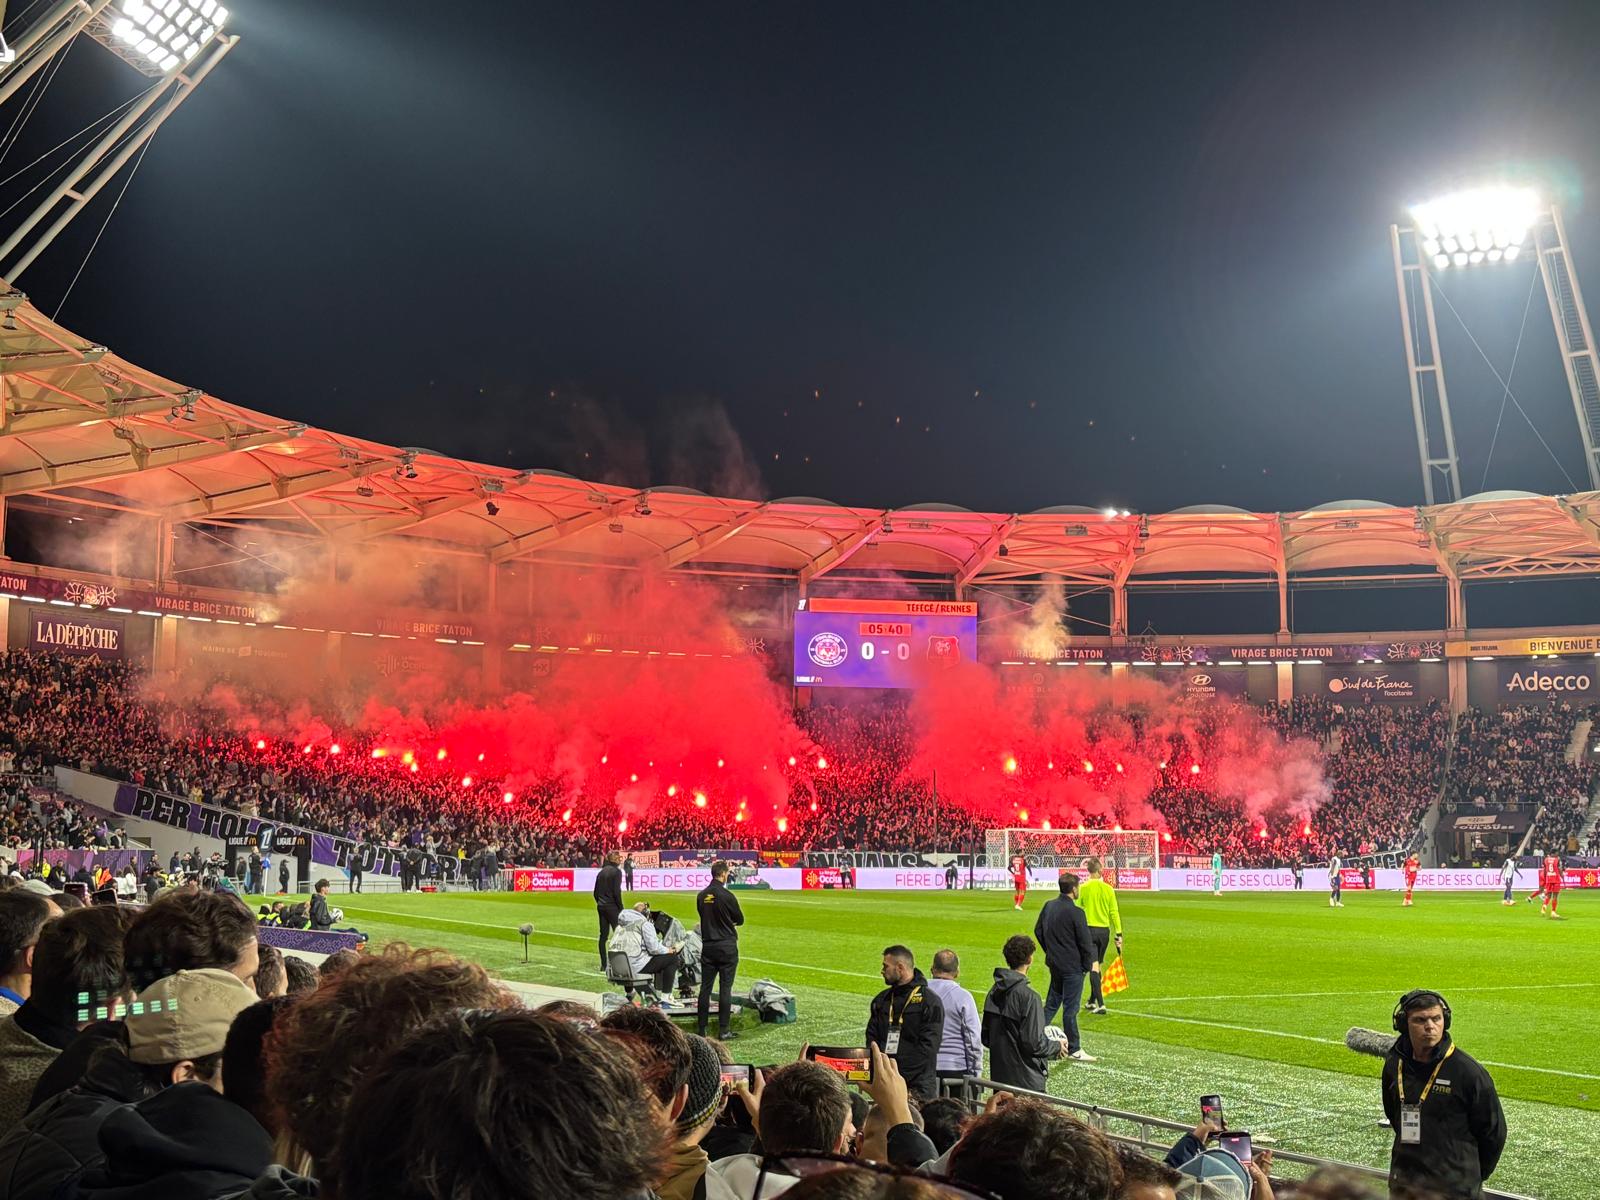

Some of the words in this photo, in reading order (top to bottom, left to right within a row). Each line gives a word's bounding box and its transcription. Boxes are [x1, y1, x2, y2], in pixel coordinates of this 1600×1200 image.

[155, 596, 190, 611] VIRAGE
[193, 601, 221, 614] BRICE
[224, 605, 255, 618] TATON
[940, 605, 972, 613] RENNES
[36, 621, 54, 643] LA
[55, 622, 118, 650] DÉPÊCHE
[413, 622, 441, 634] BRICE
[443, 624, 473, 637] TATON
[861, 642, 875, 660] 0
[897, 643, 910, 660] 0
[1530, 639, 1593, 651] BIENVENUE
[1073, 649, 1103, 658] TATON
[1231, 649, 1267, 658] VIRAGE
[1269, 648, 1299, 657] BRICE
[1301, 648, 1333, 657] TATON
[1342, 677, 1361, 691] Sud
[1361, 679, 1376, 688] de
[1375, 674, 1413, 690] France
[1506, 671, 1590, 691] Adecco
[131, 787, 192, 831] PER
[532, 878, 570, 887] Occitanie
[664, 874, 682, 888] DE
[895, 871, 931, 887] FIÈRE
[1222, 874, 1237, 886] DE
[1240, 874, 1260, 886] SES
[1438, 874, 1451, 886] DE
[1454, 874, 1472, 886] SES
